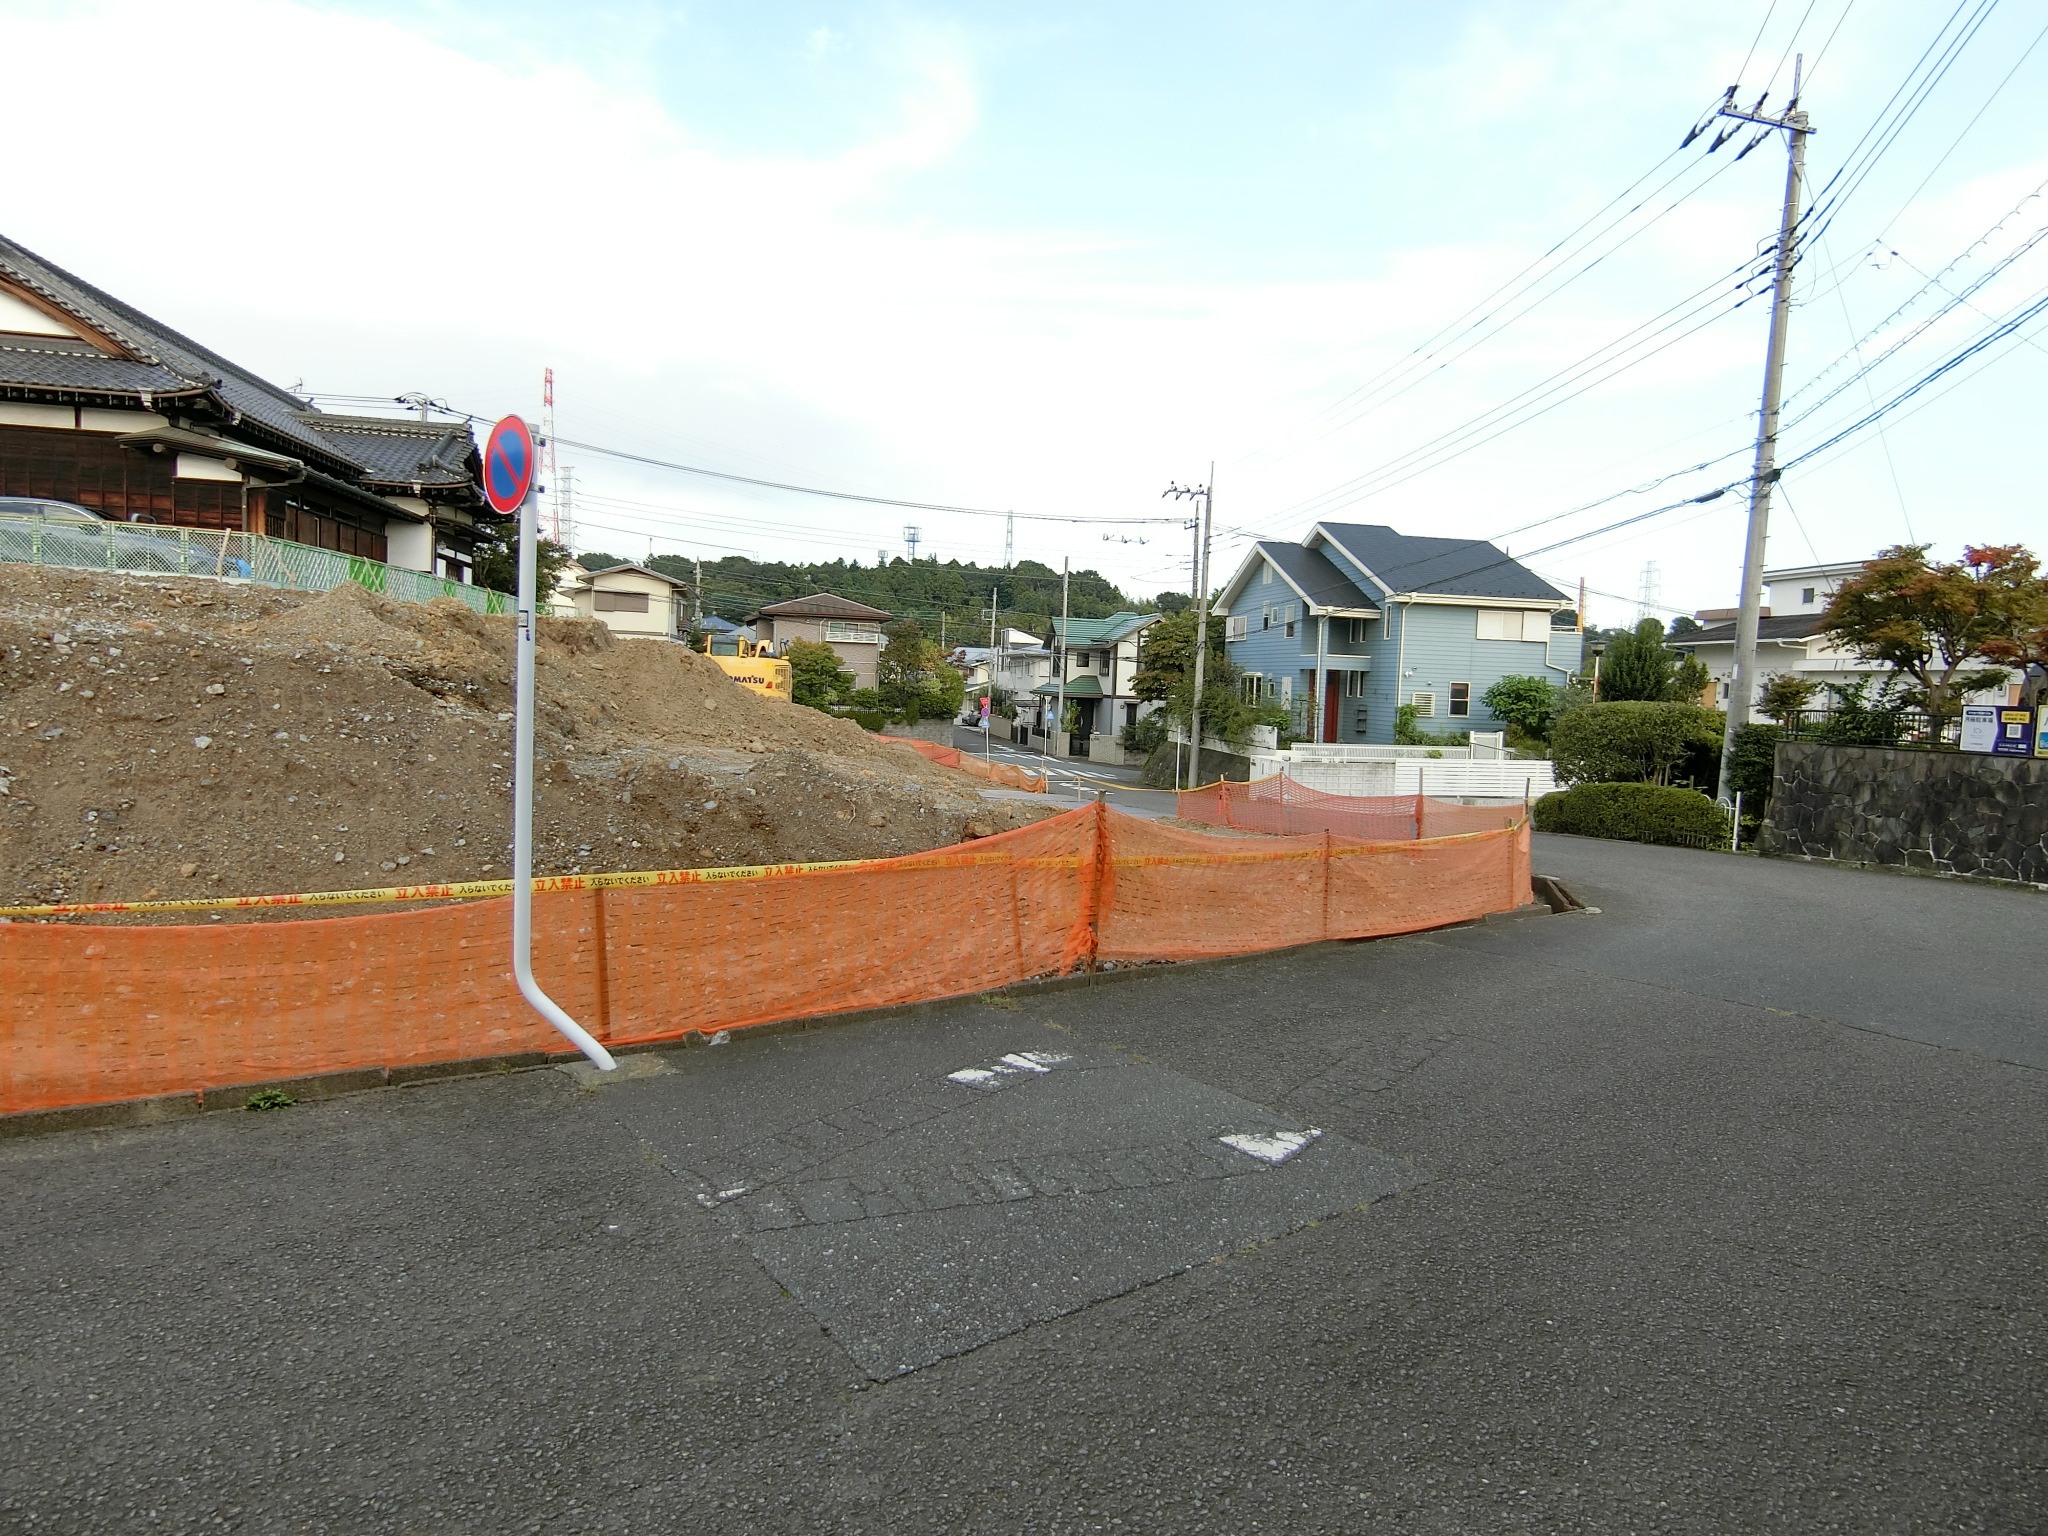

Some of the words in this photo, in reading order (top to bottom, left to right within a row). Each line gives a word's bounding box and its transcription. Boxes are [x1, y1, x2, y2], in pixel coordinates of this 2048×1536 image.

[729, 675, 764, 684] MATSU
[236, 894, 304, 906] 立入禁止
[395, 885, 454, 899] 立入禁止
[534, 877, 586, 892] 立入禁止
[590, 876, 650, 887] 入らないでください
[656, 871, 701, 885] 立入禁止
[705, 869, 758, 880] 入らないでください
[764, 864, 804, 877] 立入禁止
